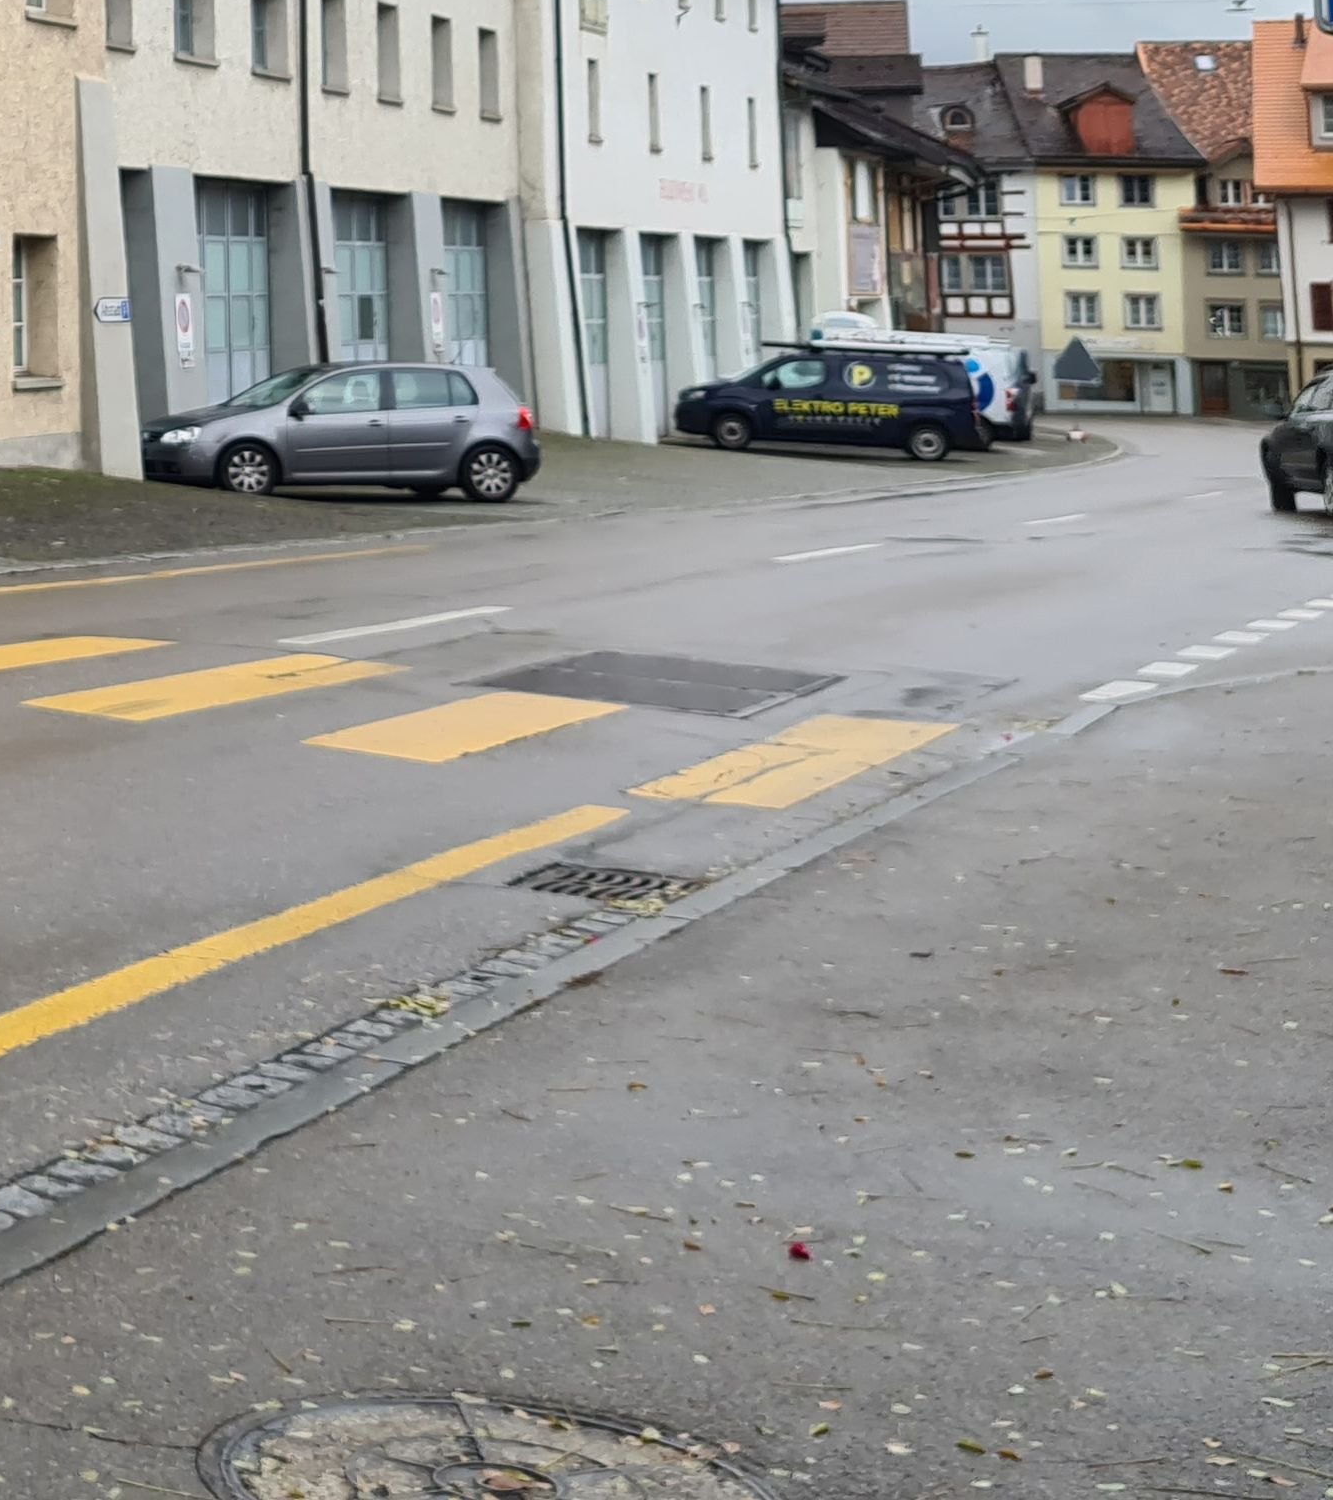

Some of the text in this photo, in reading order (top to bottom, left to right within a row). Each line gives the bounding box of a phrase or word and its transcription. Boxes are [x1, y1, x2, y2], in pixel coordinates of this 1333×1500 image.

[852, 364, 872, 388] P
[773, 399, 900, 418] ELEKTRO PETER
